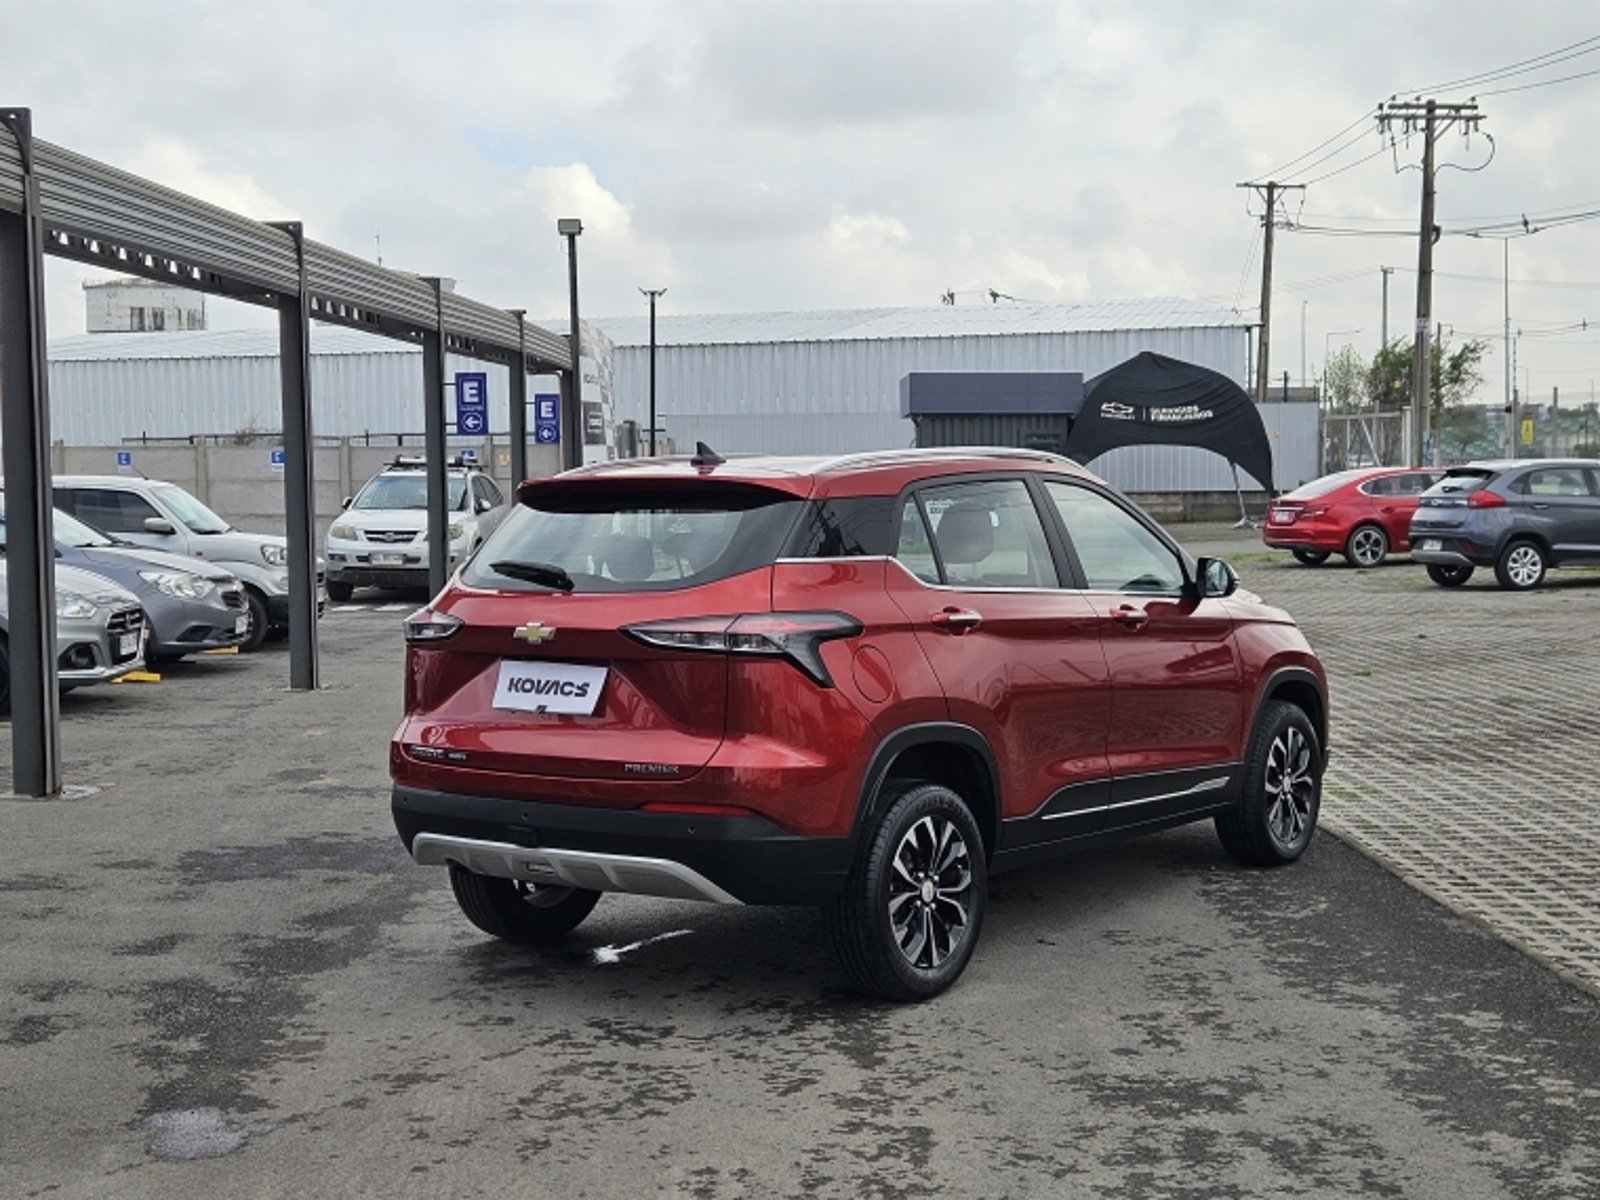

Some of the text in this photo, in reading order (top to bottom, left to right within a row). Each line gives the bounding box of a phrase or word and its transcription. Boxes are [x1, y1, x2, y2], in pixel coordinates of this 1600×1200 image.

[462, 381, 479, 403] E
[540, 401, 554, 418] E
[507, 677, 590, 698] KOVACS
